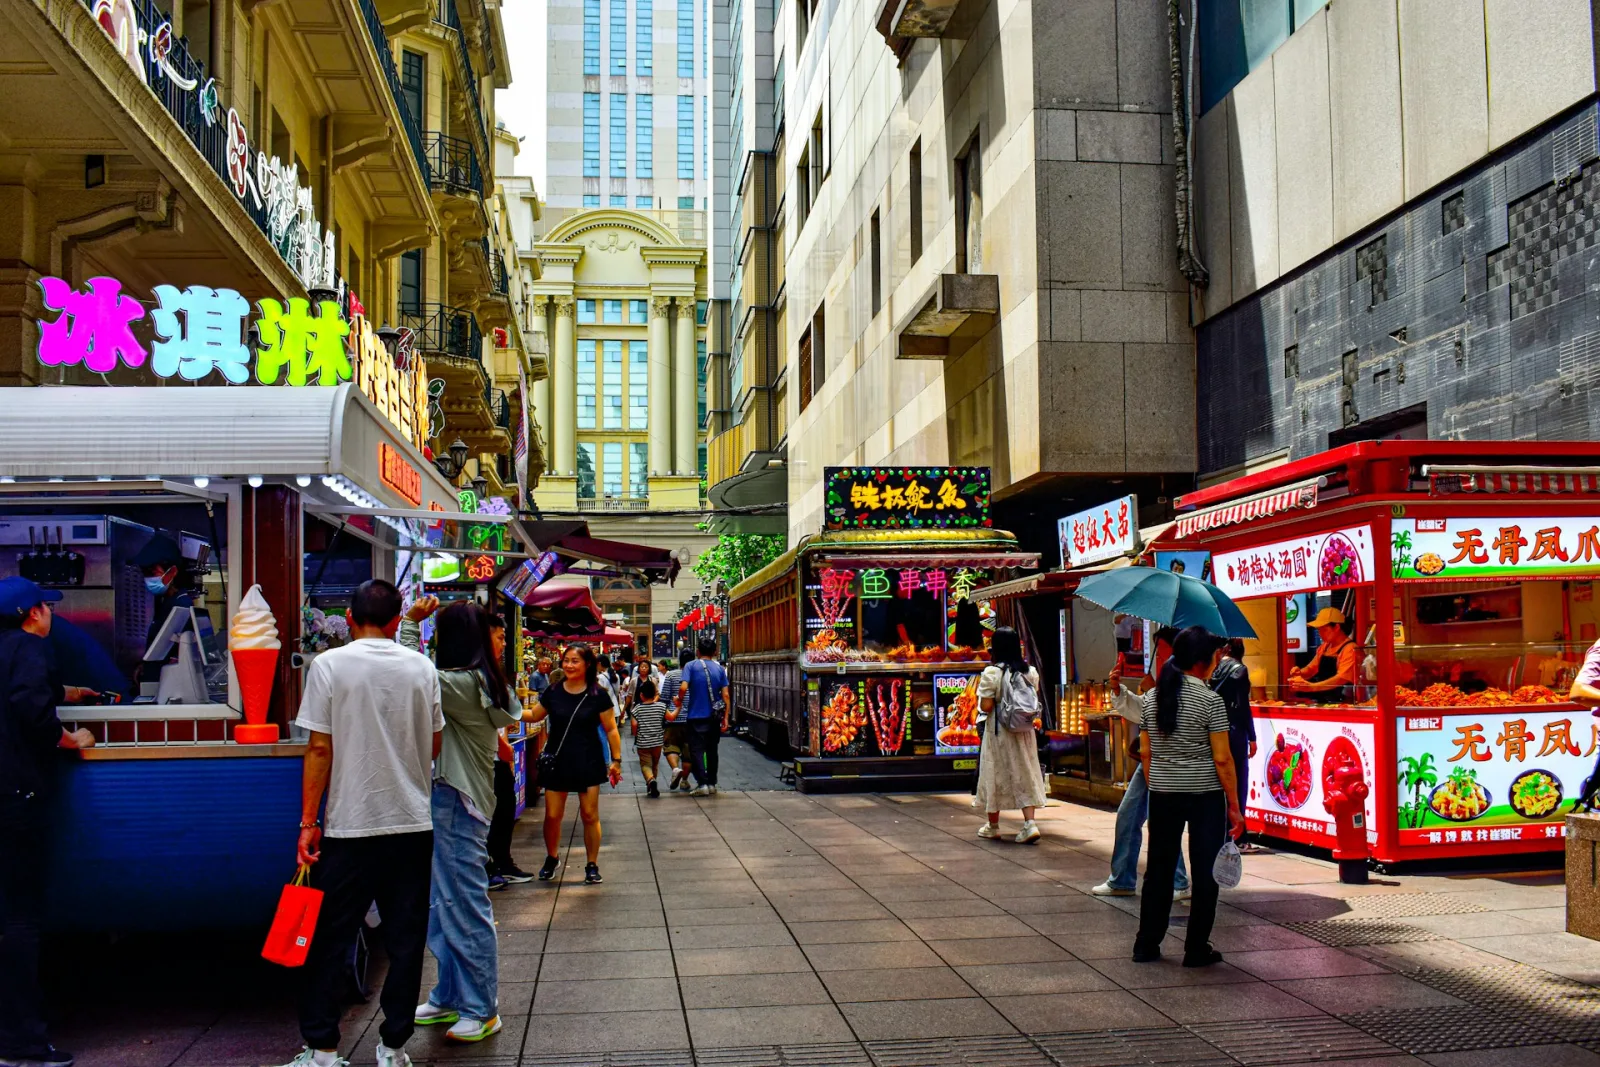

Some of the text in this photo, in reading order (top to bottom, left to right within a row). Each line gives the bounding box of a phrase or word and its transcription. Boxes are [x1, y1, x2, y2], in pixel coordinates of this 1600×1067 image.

[37, 276, 353, 386] 冰淇淋
[1073, 500, 1129, 554] 超级大串
[1393, 506, 1403, 514] 01
[1448, 525, 1600, 565] 无骨凤爪
[821, 567, 976, 600] 鱿鱼串串香
[1237, 546, 1307, 587] 杨梅冰汤圆
[1447, 718, 1596, 762] 无骨凤
